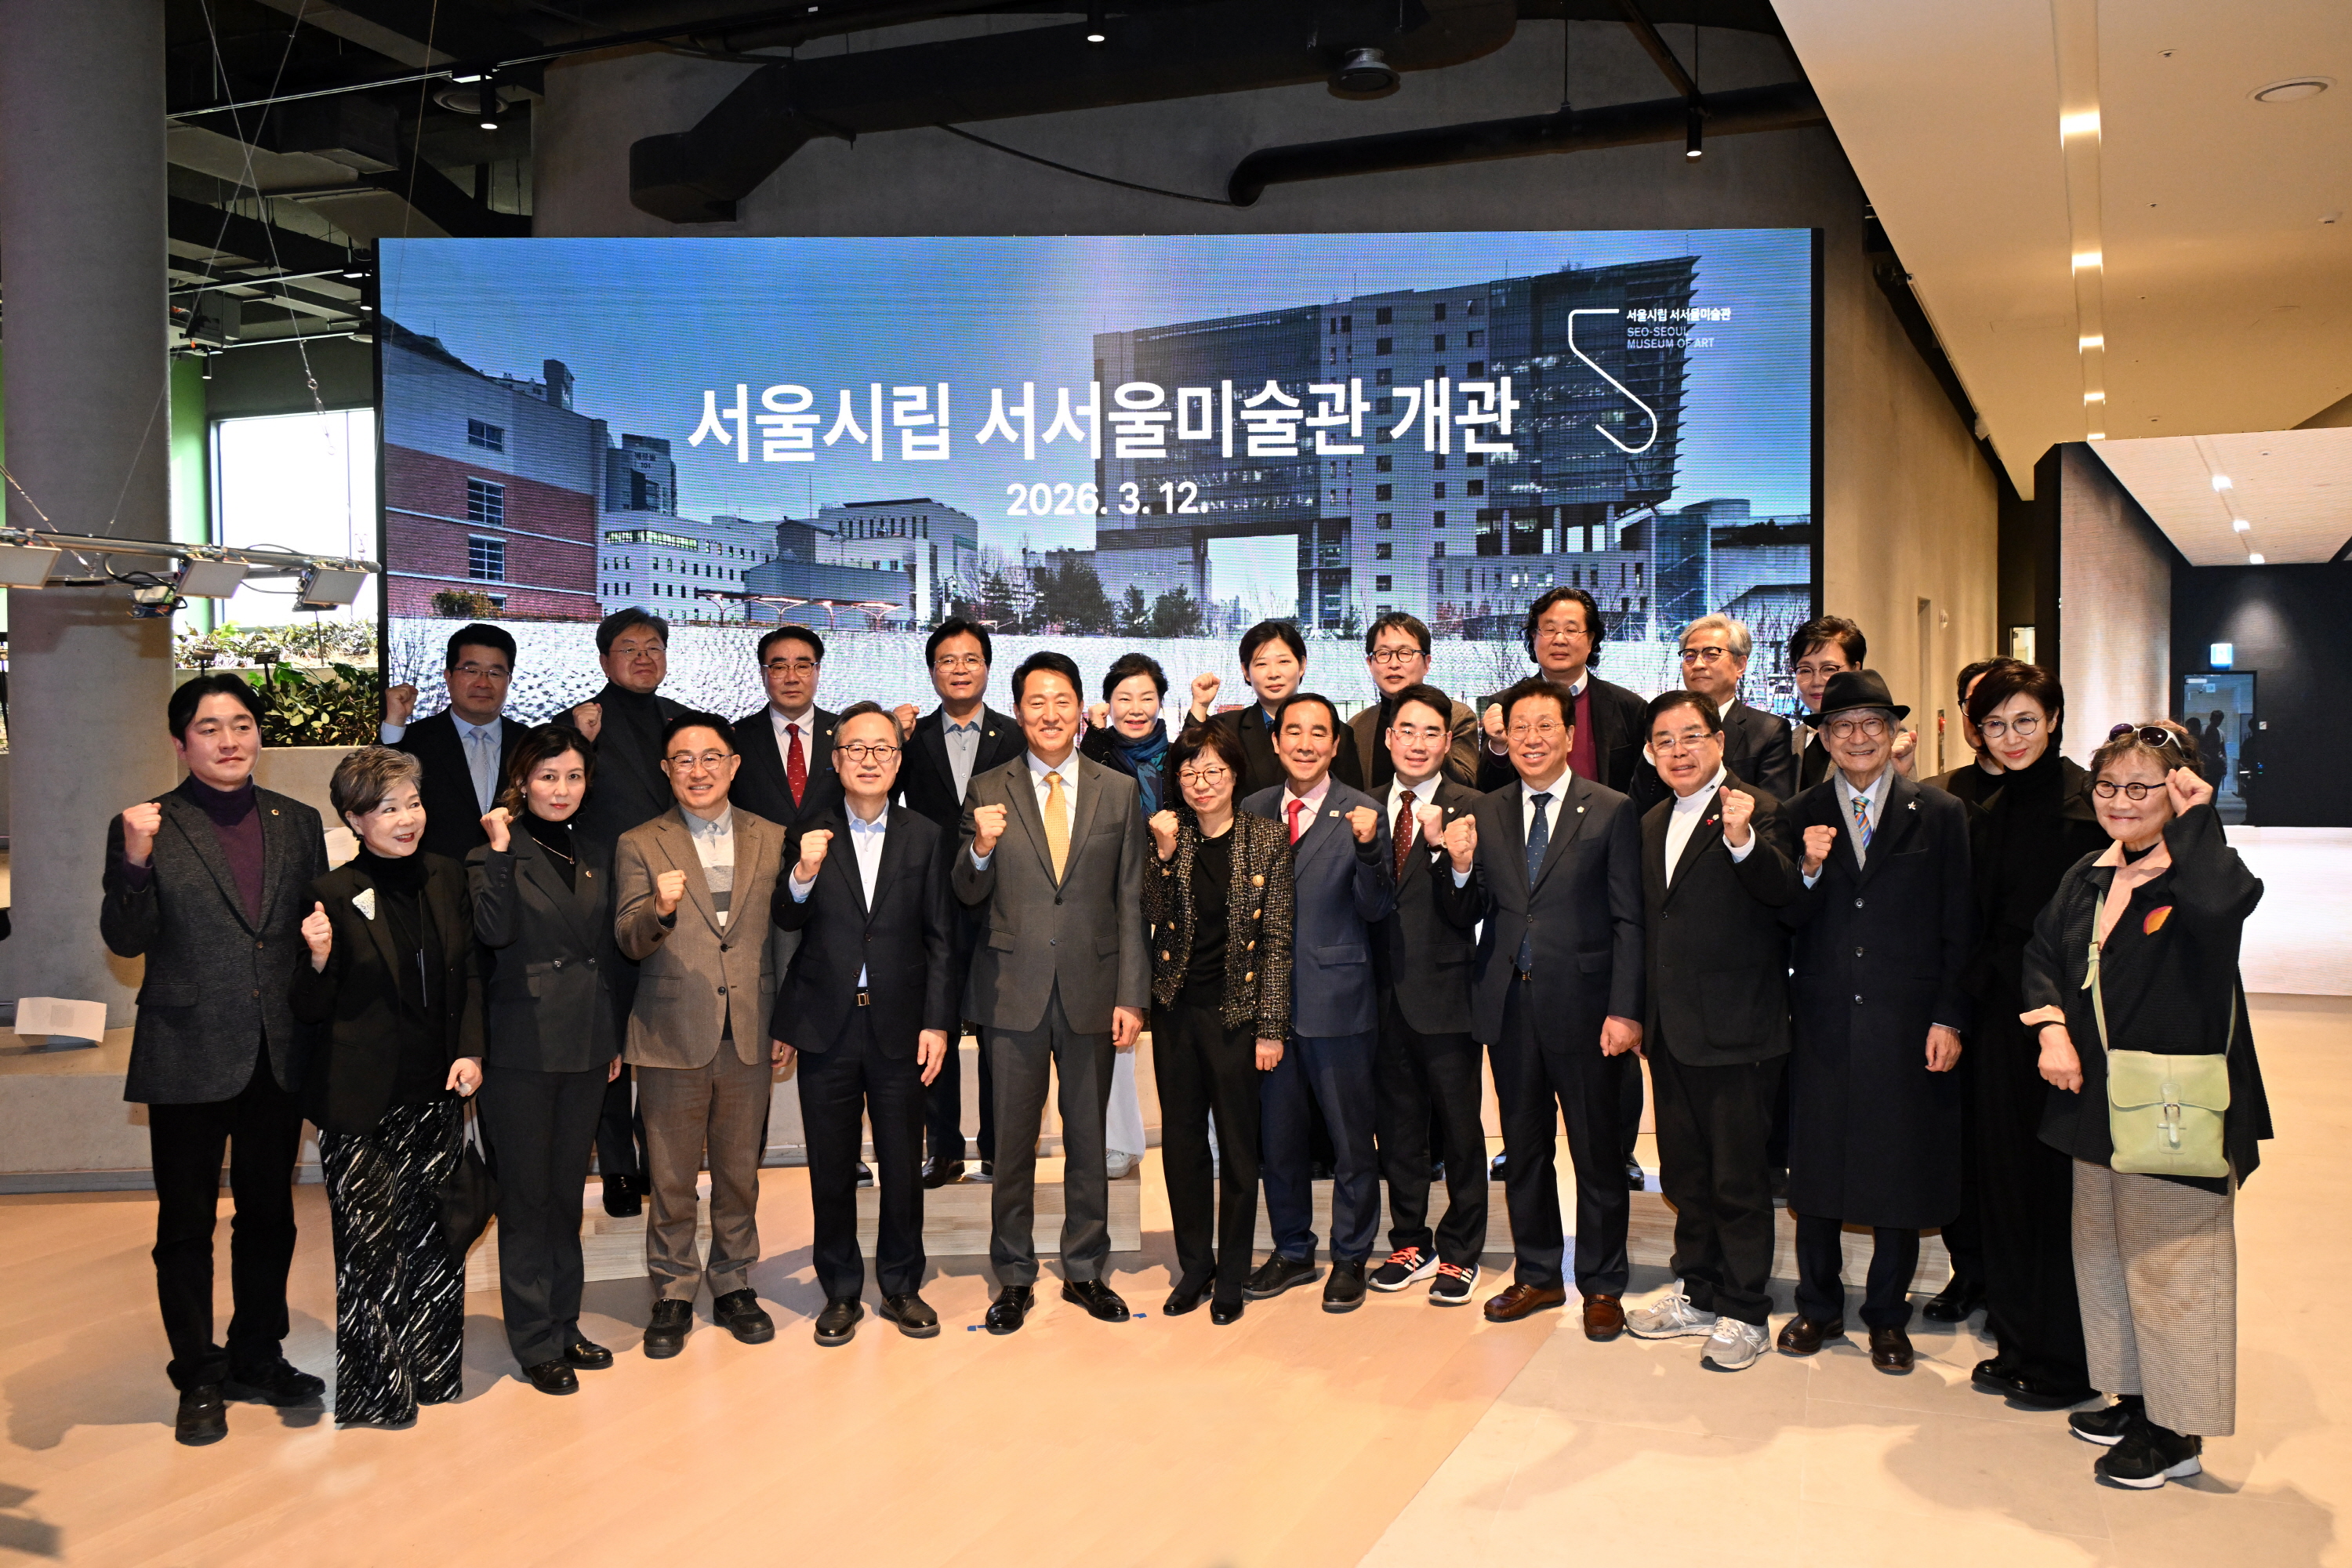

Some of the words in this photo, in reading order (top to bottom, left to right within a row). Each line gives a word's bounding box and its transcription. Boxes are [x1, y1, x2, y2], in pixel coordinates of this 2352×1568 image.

[1627, 308, 1668, 322] 서울시립
[1669, 307, 1731, 321] 서서울미술관
[1627, 326, 1689, 337] SEO-SEOUL
[1627, 338, 1674, 349] MUSEUM
[1676, 338, 1692, 349] OF
[1693, 337, 1715, 348] ART
[688, 383, 950, 463] 서울시립
[975, 379, 1371, 460] 서서울미술관
[1390, 376, 1520, 455] 개관
[1007, 482, 1109, 516] 2026.
[1118, 482, 1150, 514] 3.
[1159, 481, 1208, 514] 12.
